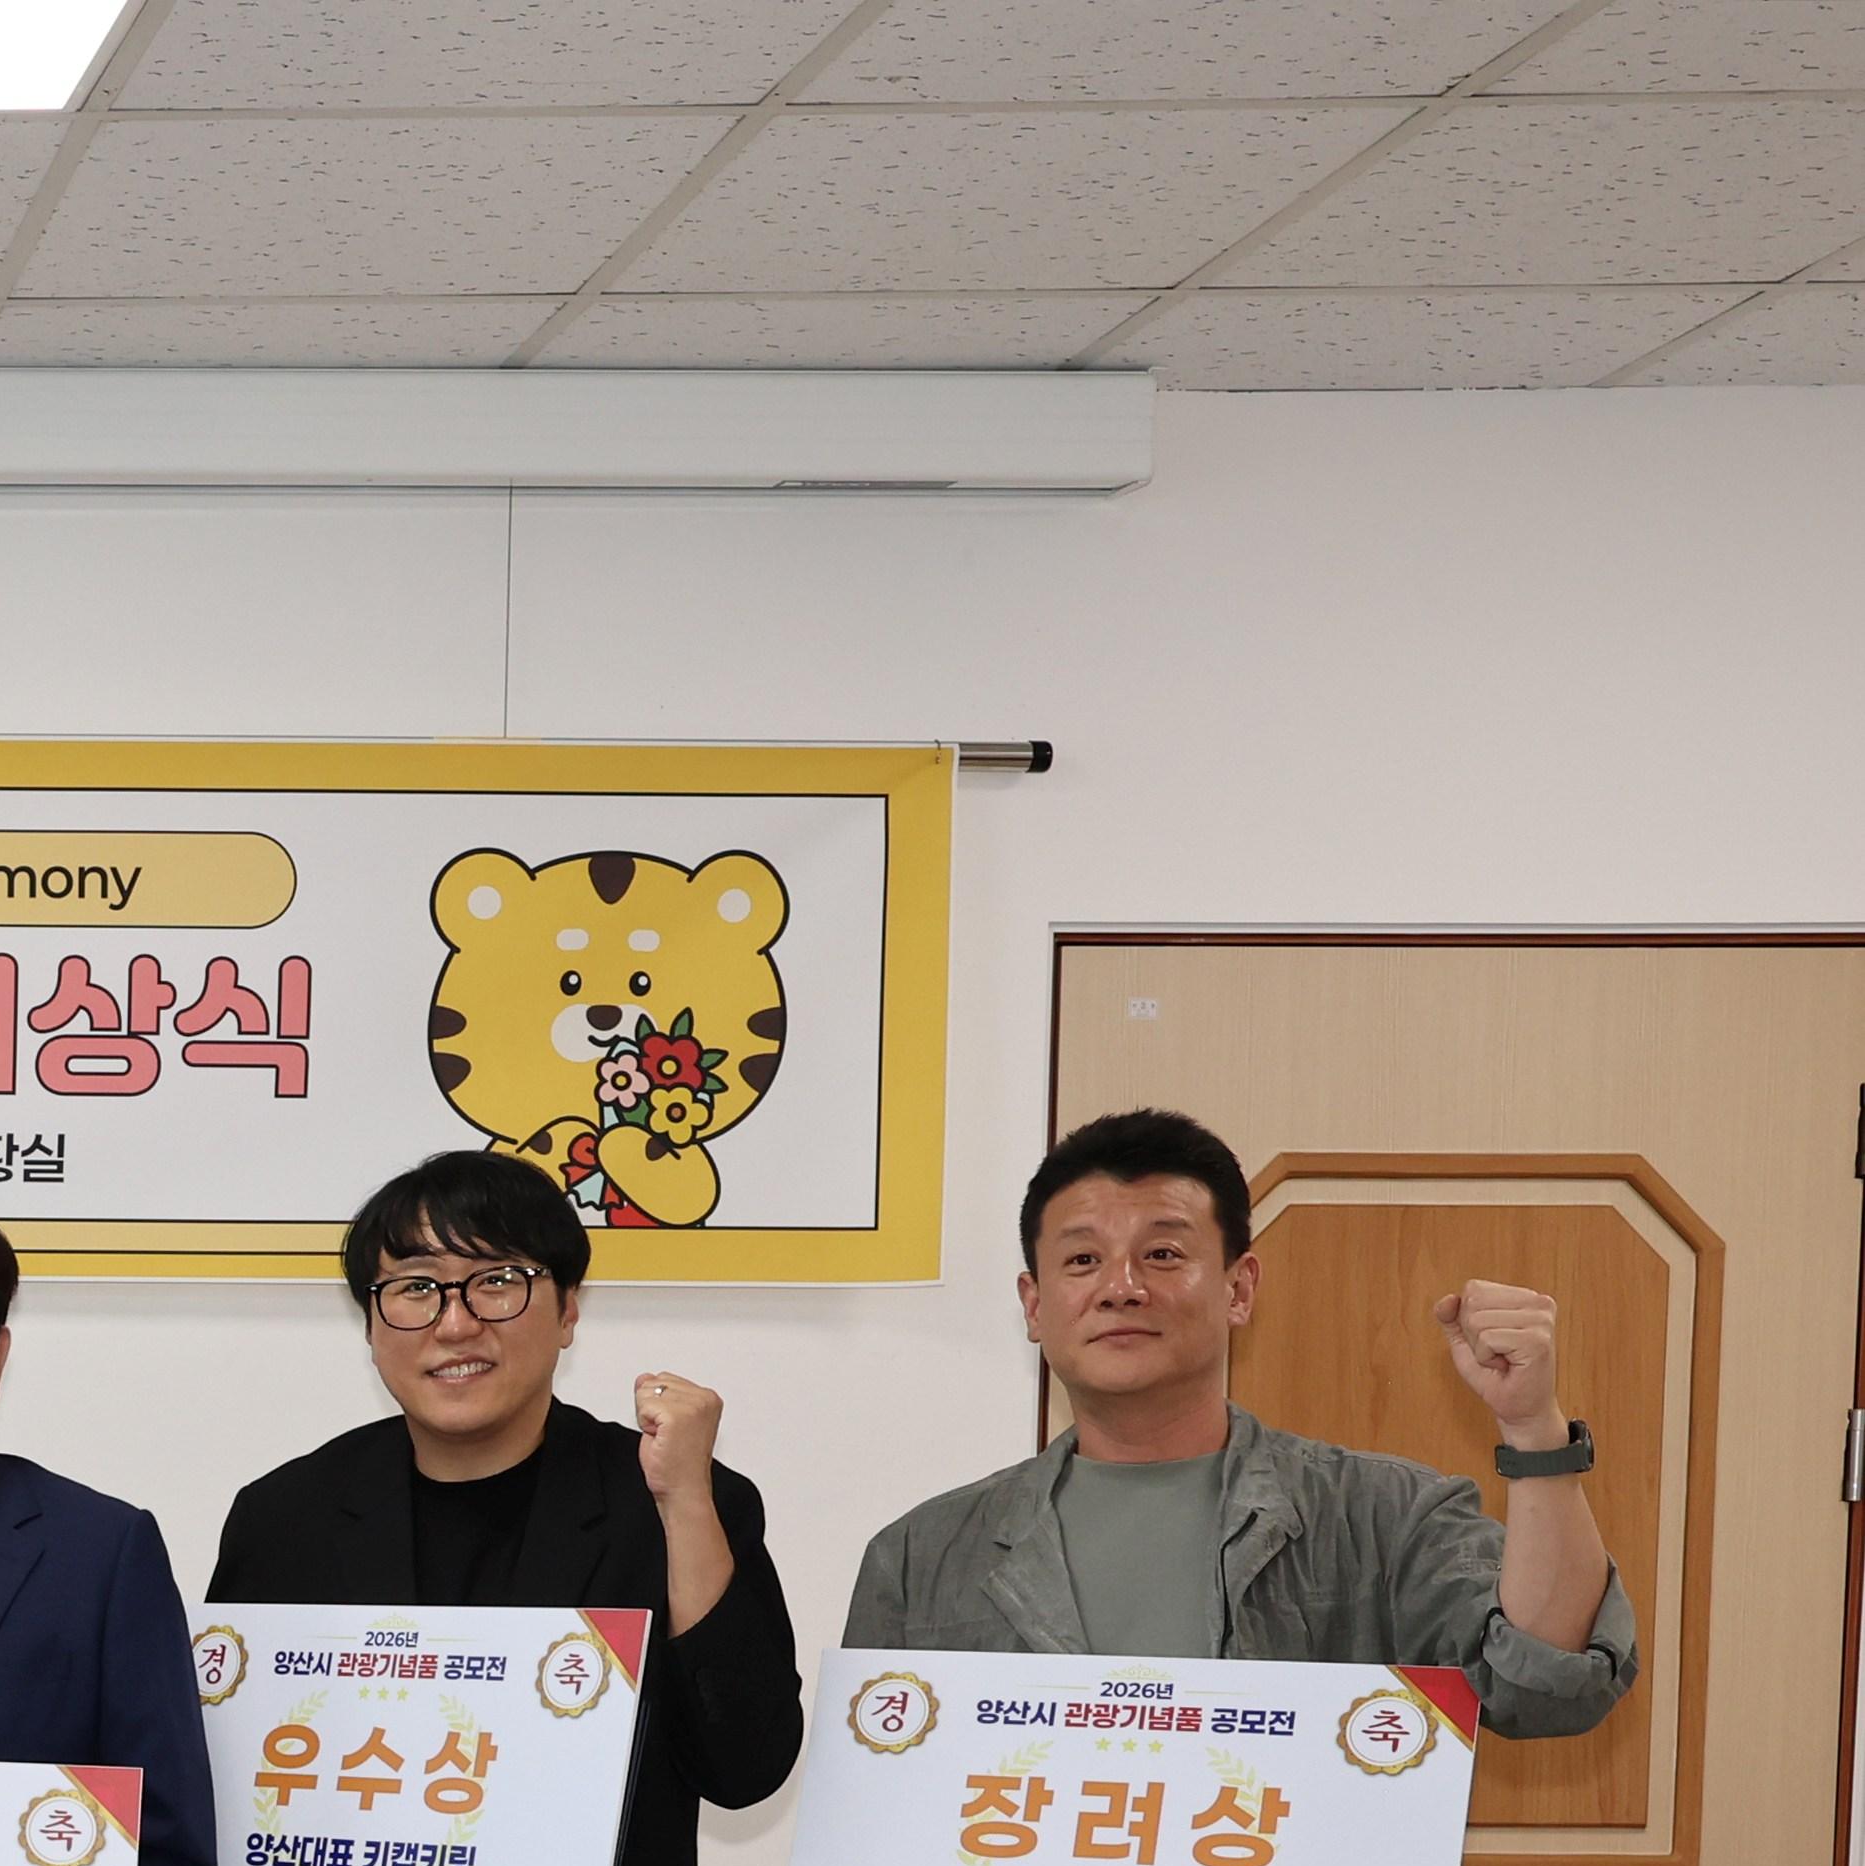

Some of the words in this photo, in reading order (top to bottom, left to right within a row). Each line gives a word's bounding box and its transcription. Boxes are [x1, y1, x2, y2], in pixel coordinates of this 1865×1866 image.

[365, 1631, 418, 1648] 2026년
[199, 1645, 226, 1684] 경
[274, 1651, 333, 1676] 양산시
[337, 1653, 438, 1679] 관광기념품
[444, 1655, 507, 1681] 공모전
[555, 1654, 589, 1695] 축
[1100, 1682, 1173, 1700] 2026년
[872, 1691, 909, 1732] 경
[977, 1700, 1057, 1726] 양산시
[1065, 1703, 1202, 1732] 관광기념품
[1211, 1708, 1296, 1736] 공모전
[1362, 1710, 1410, 1752] 축
[40, 1810, 81, 1851] 축
